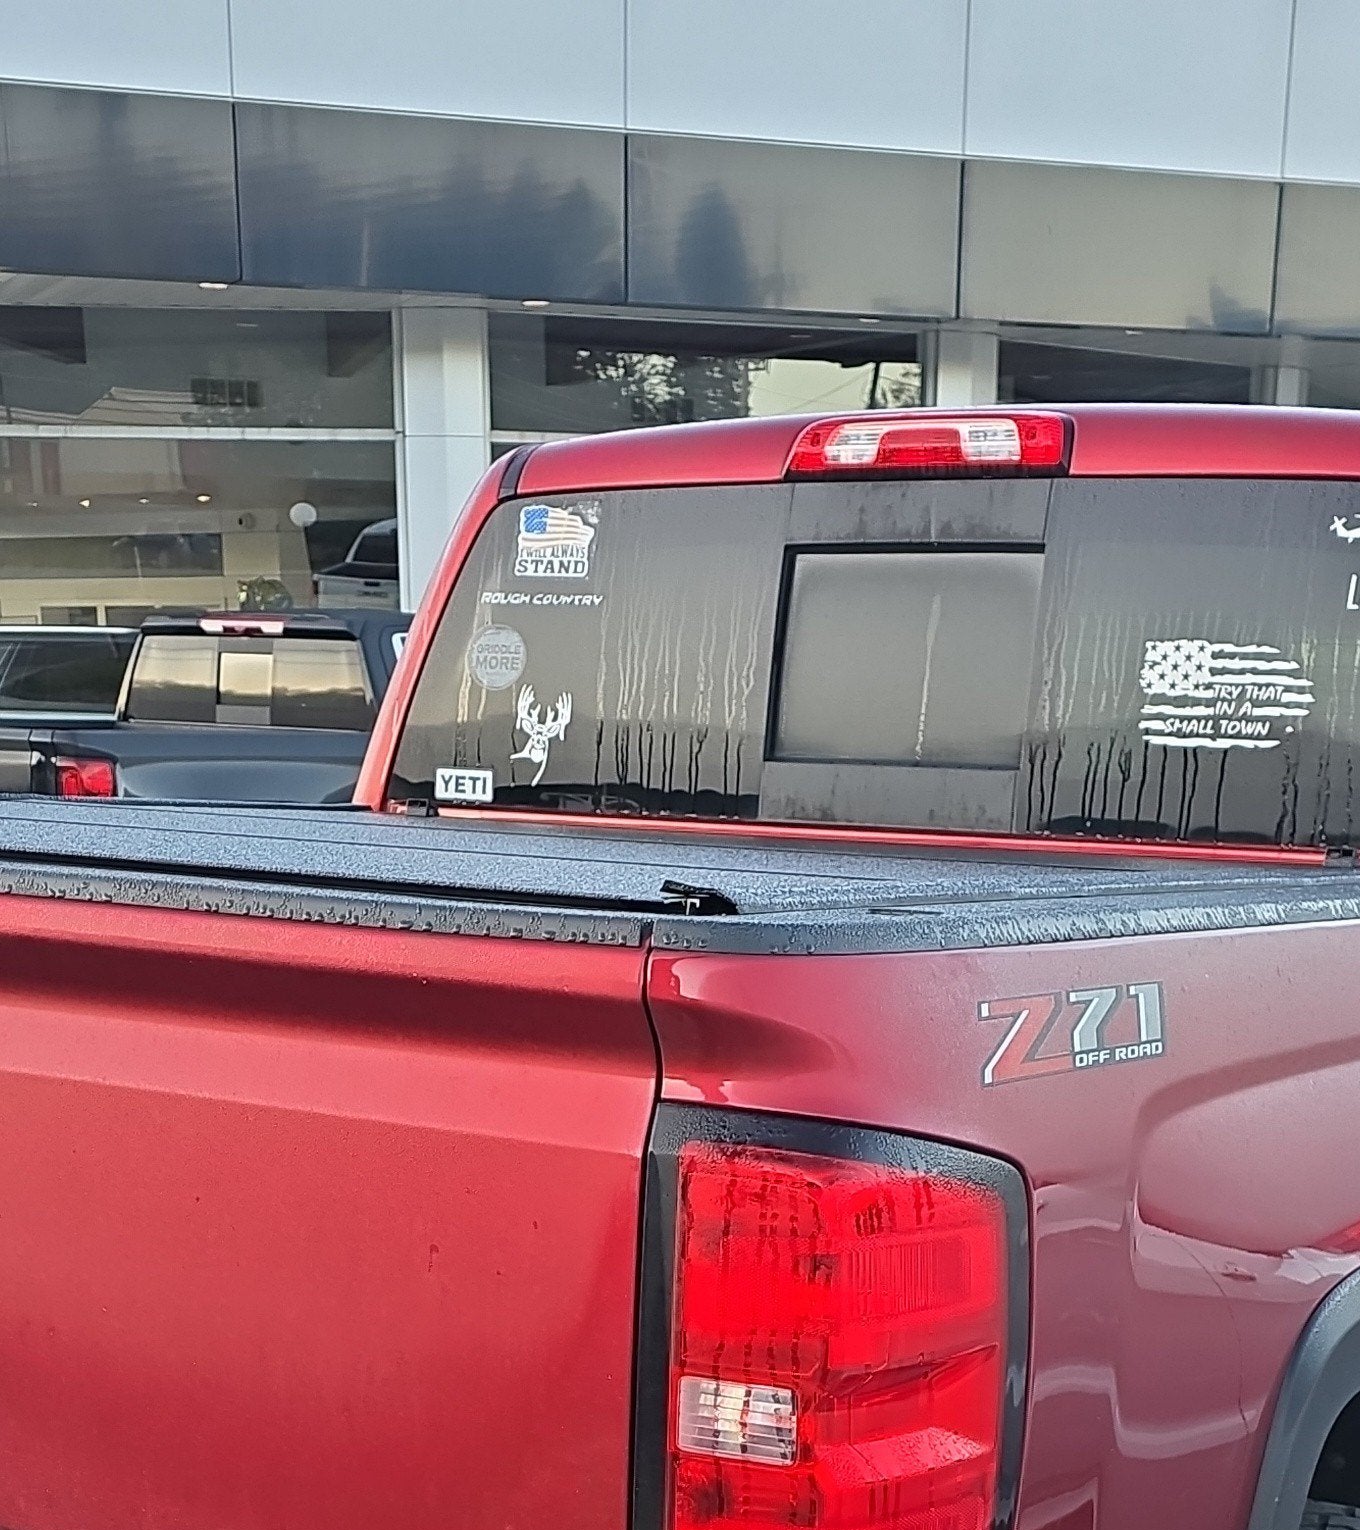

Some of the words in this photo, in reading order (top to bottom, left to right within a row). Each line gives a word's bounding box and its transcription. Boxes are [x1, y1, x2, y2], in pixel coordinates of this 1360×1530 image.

[525, 547, 547, 558] WILL
[549, 544, 586, 558] ALWAYS
[516, 560, 586, 574] STAND
[480, 592, 530, 604] ROUGH
[532, 593, 603, 606] COUNTRY
[476, 643, 521, 655] GRIDDLE
[476, 655, 520, 670] MORE
[1213, 684, 1245, 700] TRY
[1245, 685, 1284, 700] THAT
[1214, 701, 1236, 716] IN
[1239, 701, 1253, 716] A
[1164, 719, 1215, 735] SMALL
[1219, 720, 1271, 736] TOWN
[441, 775, 487, 794] YETI
[978, 981, 1163, 1086] Z71
[1075, 1050, 1111, 1067] OFF
[1115, 1042, 1163, 1061] ROAD
